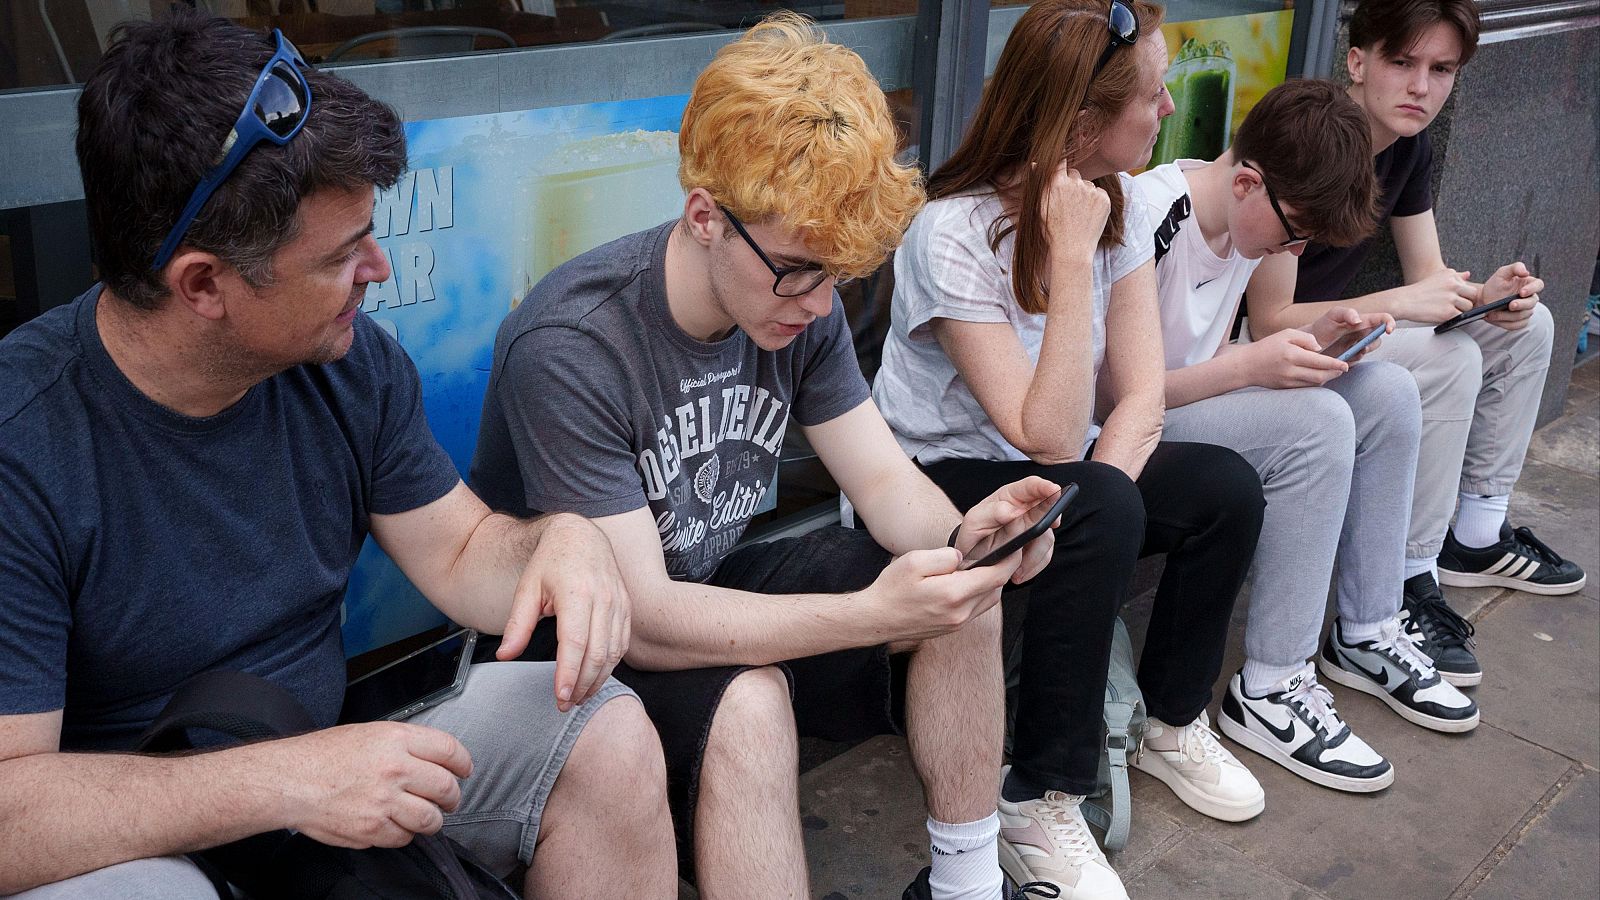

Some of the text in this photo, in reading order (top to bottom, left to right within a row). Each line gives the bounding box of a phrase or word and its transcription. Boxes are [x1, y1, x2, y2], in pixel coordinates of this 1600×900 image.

[360, 241, 436, 314] AR
[657, 510, 707, 552] Limite
[706, 525, 747, 560] APPARE
[1290, 674, 1301, 687] NIKE
